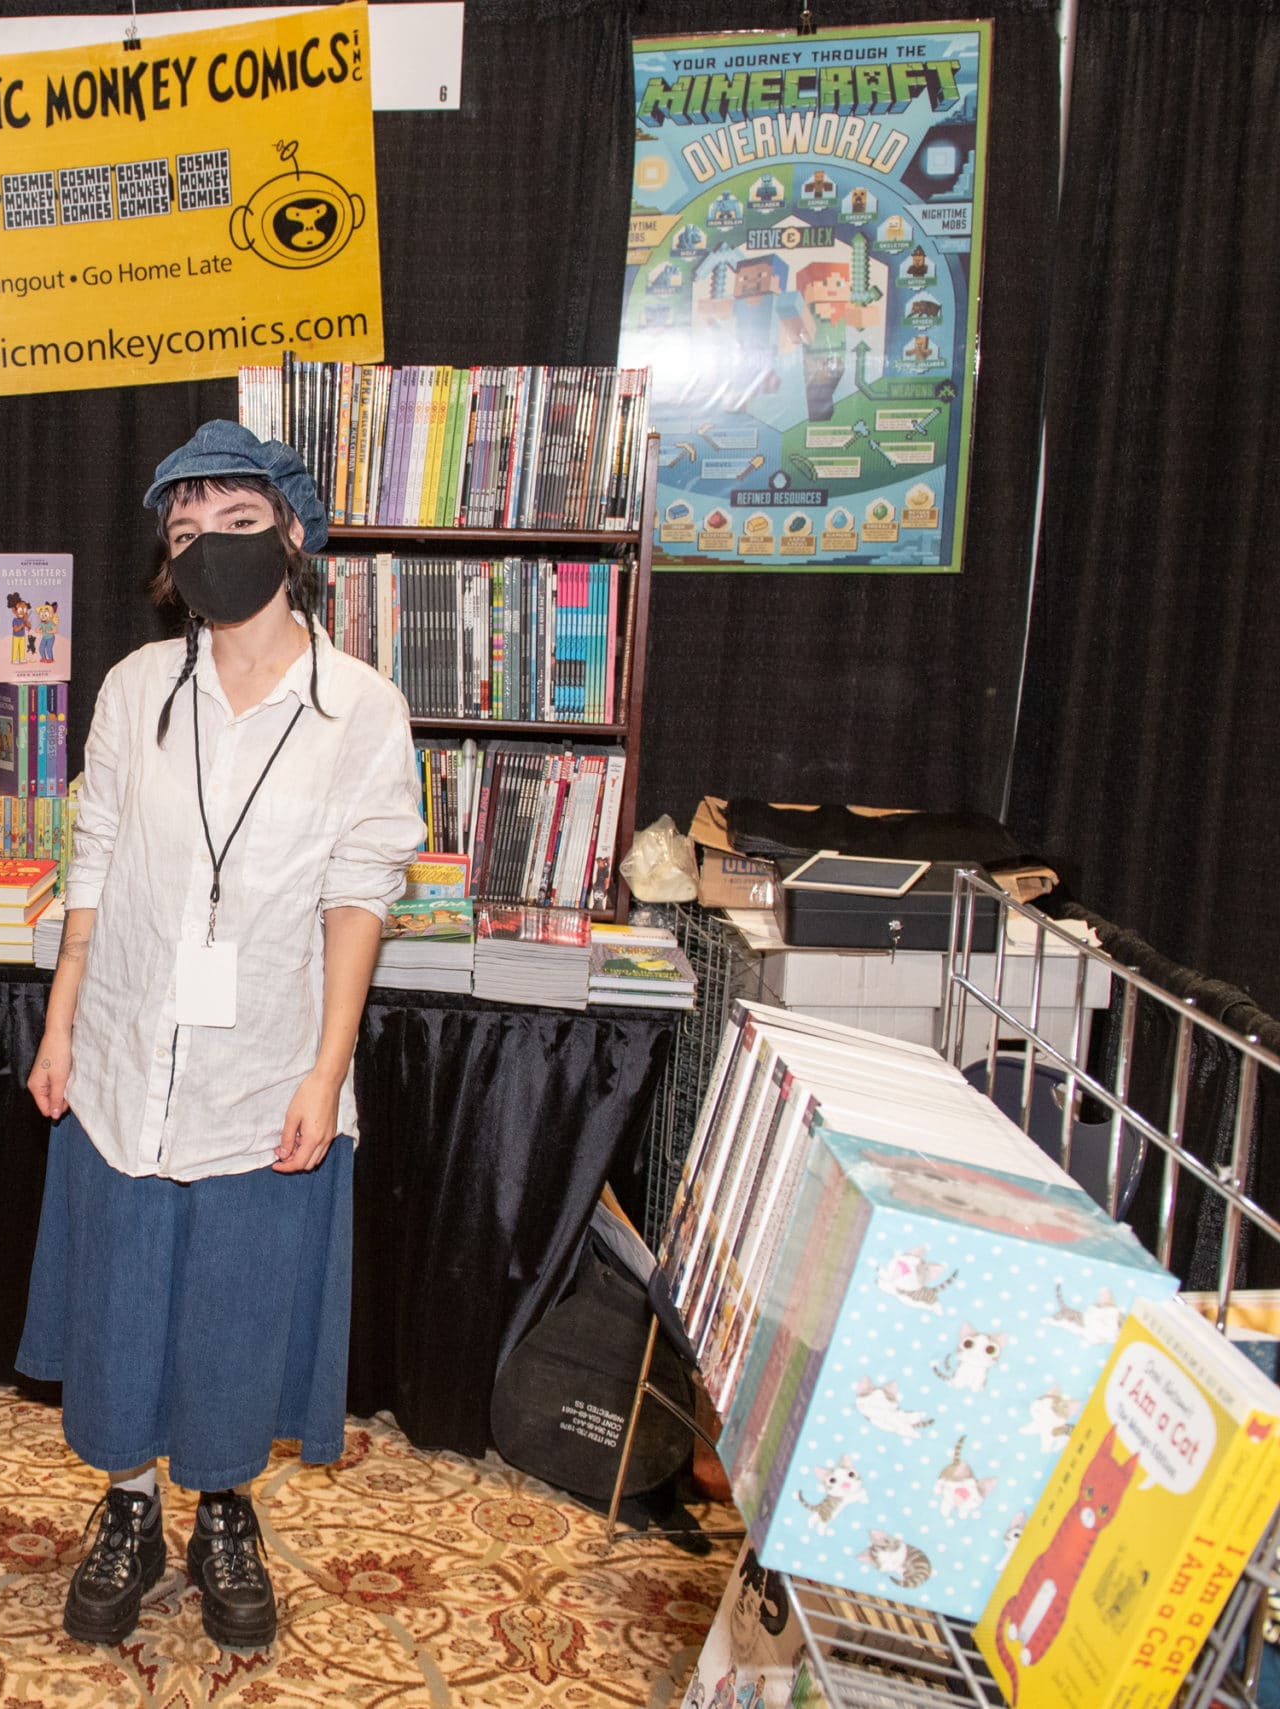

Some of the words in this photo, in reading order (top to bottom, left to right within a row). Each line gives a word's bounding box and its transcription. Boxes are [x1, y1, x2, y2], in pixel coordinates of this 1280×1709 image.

[673, 57, 717, 71] YOUR
[724, 51, 803, 67] JOURNEY
[812, 46, 889, 63] THROUGH
[897, 45, 926, 59] THE
[46, 56, 197, 128] MONKEY
[208, 32, 349, 103] COMICS
[438, 85, 448, 102] 6
[638, 59, 961, 127] MINECRAFT
[681, 111, 910, 183] OVERWORLD
[118, 160, 167, 182] COSMIC
[179, 151, 228, 172] COSMIC
[4, 173, 54, 193] COSMIC
[60, 167, 110, 187] COSMIC
[180, 169, 228, 191] MONKEY
[61, 184, 111, 204] MONKEY
[119, 178, 167, 199] MONKEY
[181, 187, 230, 208] COMICS
[5, 190, 54, 210] MONKEY
[120, 196, 168, 218] COMICS
[6, 208, 55, 228] COMICS
[63, 202, 112, 223] COMICS
[921, 208, 967, 220] NIGHTTIME
[942, 220, 967, 230] MOBS
[748, 229, 781, 249] STEVE
[802, 227, 832, 246] ALEX
[82, 265, 113, 287] Go
[119, 261, 181, 283] Home
[188, 256, 233, 277] Late
[737, 491, 771, 504] REFINED
[773, 491, 822, 505] RESOURCES
[586, 1404, 625, 1424] INSPECTED
[1116, 1365, 1132, 1389] I
[1130, 1383, 1157, 1419] Am
[1158, 1412, 1169, 1431] a
[1169, 1421, 1200, 1466] Cat
[600, 1419, 622, 1432] CONT
[1195, 1534, 1215, 1549] I
[1226, 1544, 1245, 1558] I
[1167, 1552, 1204, 1597] Am
[1200, 1561, 1235, 1607] Am
[1158, 1603, 1175, 1619] a
[1186, 1614, 1204, 1628] a
[1132, 1626, 1168, 1670] Cat
[1161, 1635, 1196, 1677] Cat
